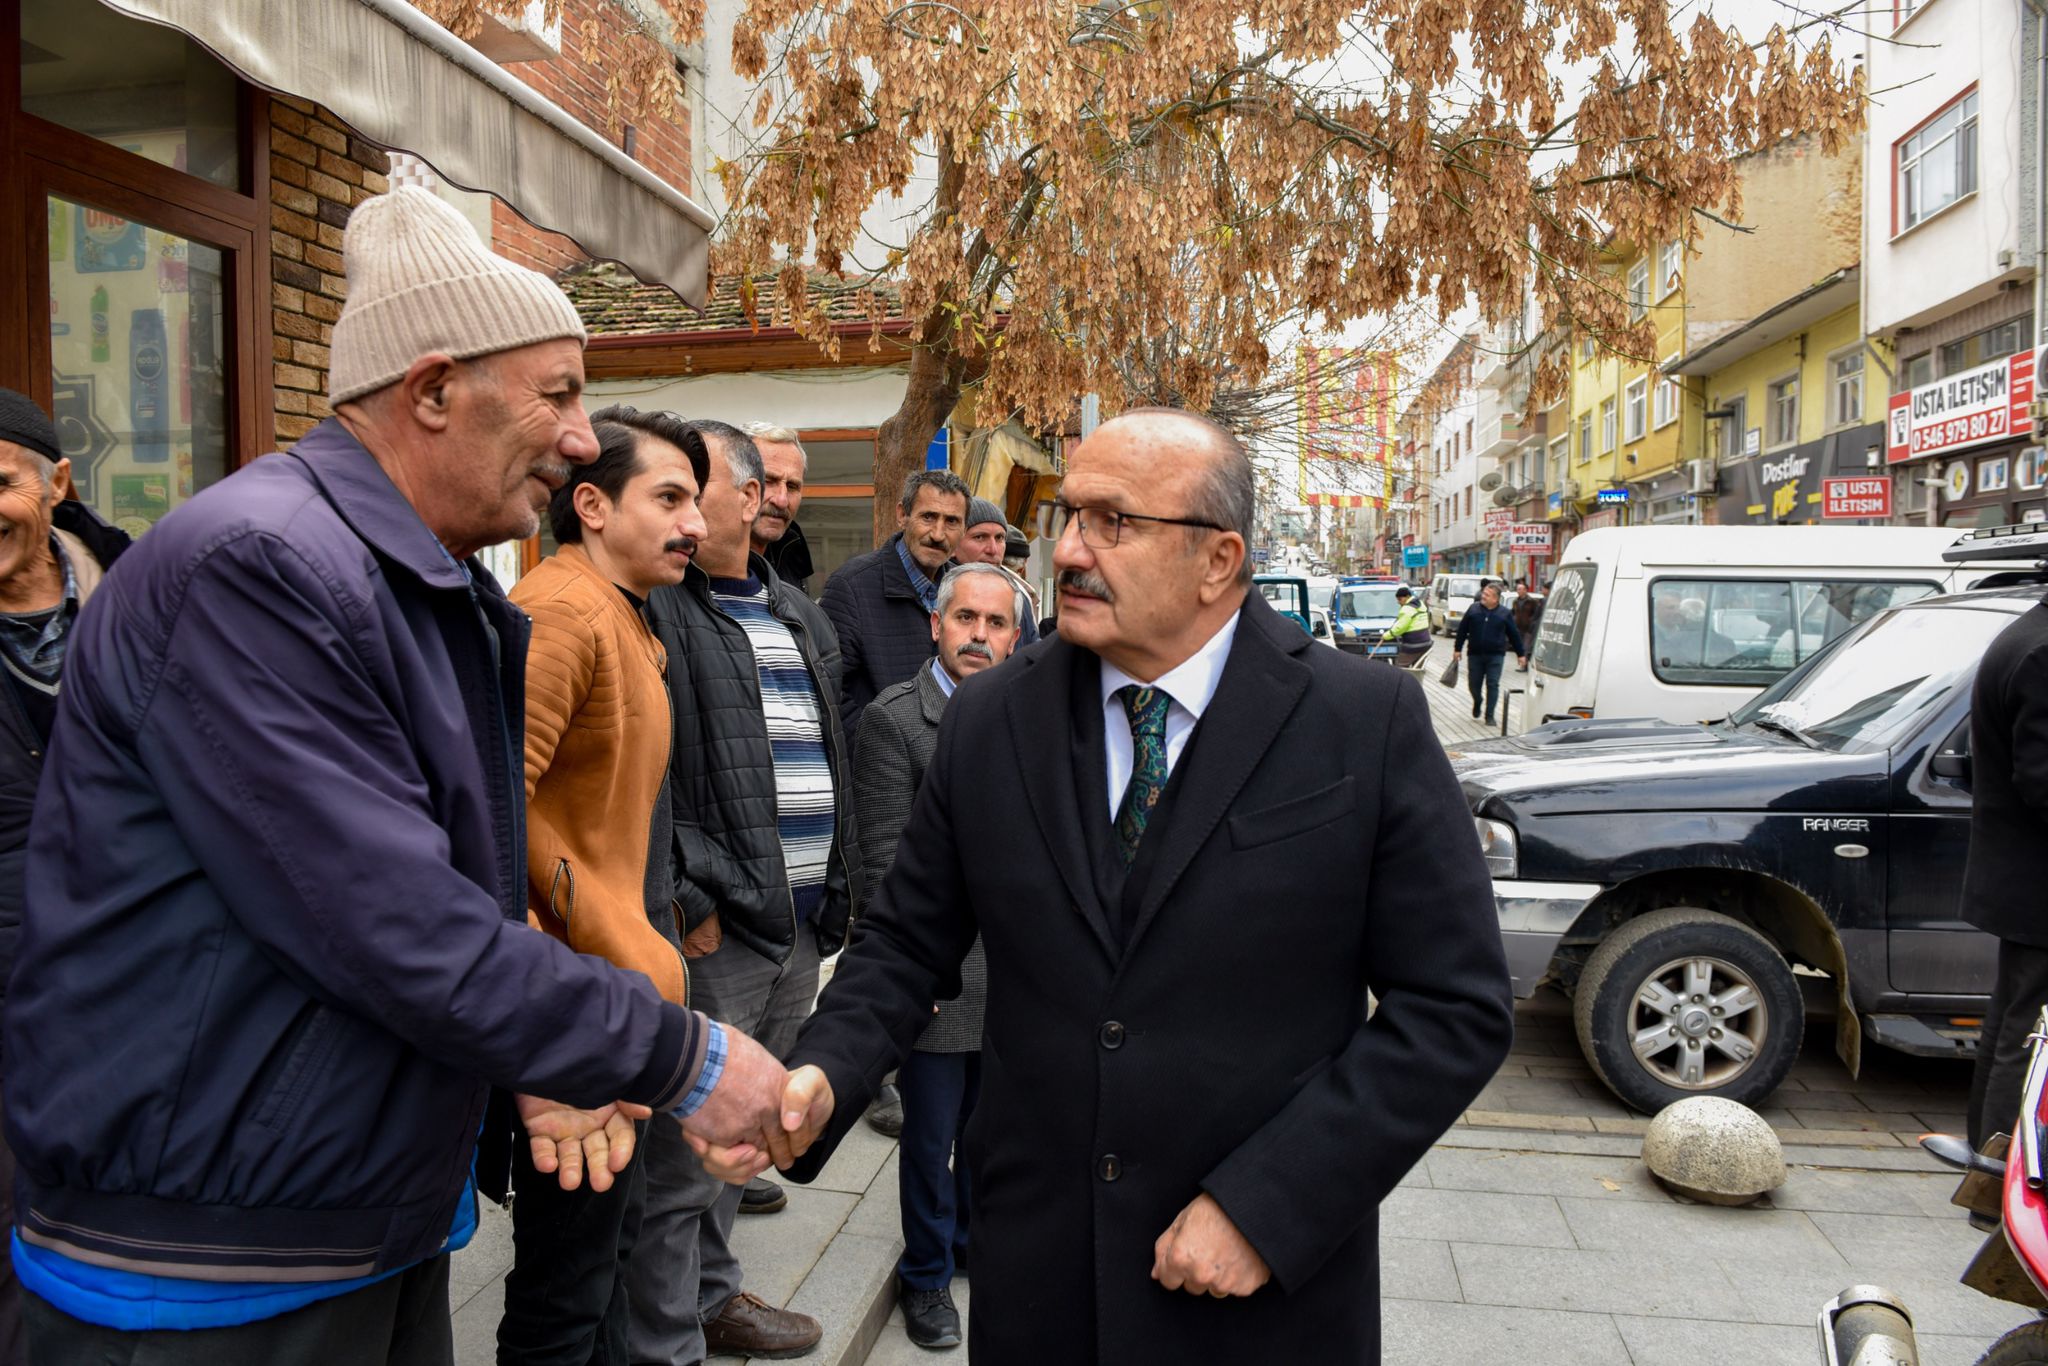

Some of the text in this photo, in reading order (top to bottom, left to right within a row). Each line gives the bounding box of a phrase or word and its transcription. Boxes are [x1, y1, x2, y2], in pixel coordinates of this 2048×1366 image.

[1913, 386, 1945, 420] USTA
[1913, 407, 2006, 451] 0 546 979 80 27
[1762, 453, 1810, 485] Dostlar
[1850, 481, 1883, 495] USTA
[1512, 525, 1550, 534] MUTLU
[1802, 818, 1870, 832] RANGER
